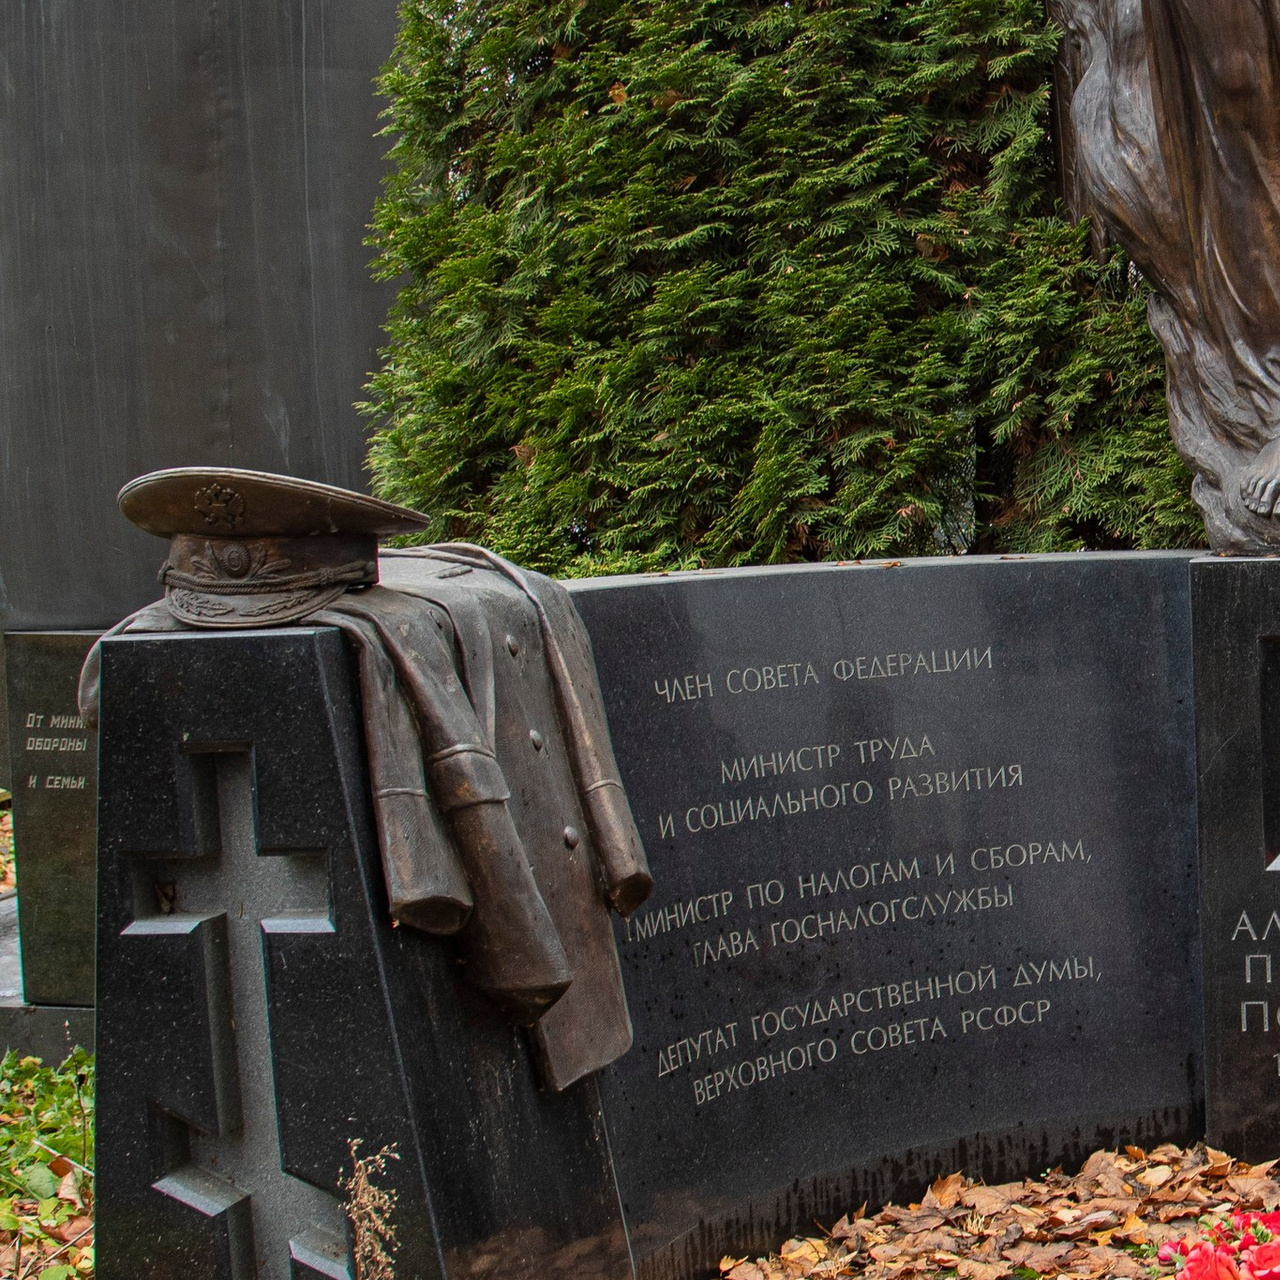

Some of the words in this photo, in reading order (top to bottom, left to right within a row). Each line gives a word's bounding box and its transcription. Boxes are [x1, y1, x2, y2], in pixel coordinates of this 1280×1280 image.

[655, 673, 713, 703] ЧЛЕН
[726, 664, 819, 694] СОВЕТА
[833, 646, 992, 682] ФЕДЕРАЦИИ
[26, 737, 87, 751] ОБОРОНЫ
[721, 744, 840, 784] МИНИСТР
[854, 735, 935, 762] ТРУДА
[28, 775, 37, 788] И
[46, 775, 86, 789] СЕМЬИ
[659, 814, 675, 839] И
[685, 780, 873, 833] СОЦИАЛЬНОГО
[888, 764, 1023, 800] РАЗВИТИЯ
[635, 891, 733, 942] МИНИСТР
[747, 881, 784, 910] ПО
[799, 859, 920, 899] НАЛОГАМ
[937, 853, 954, 876] И
[970, 839, 1092, 872] СБОРАМ,
[693, 928, 760, 968] ГЛАВА
[771, 884, 1014, 947] ГОСНАЛОГСЛУЖБЫ
[657, 1023, 738, 1078] ДЕПУТАТ
[750, 964, 997, 1041] ГОСУДАРСТВЕННОЙ
[1013, 956, 1102, 987] ДУМЫ,
[693, 1039, 837, 1106] ВЕРХОВНОГО
[850, 1017, 947, 1055] СОВЕТА
[961, 999, 1051, 1034] РСФСР
